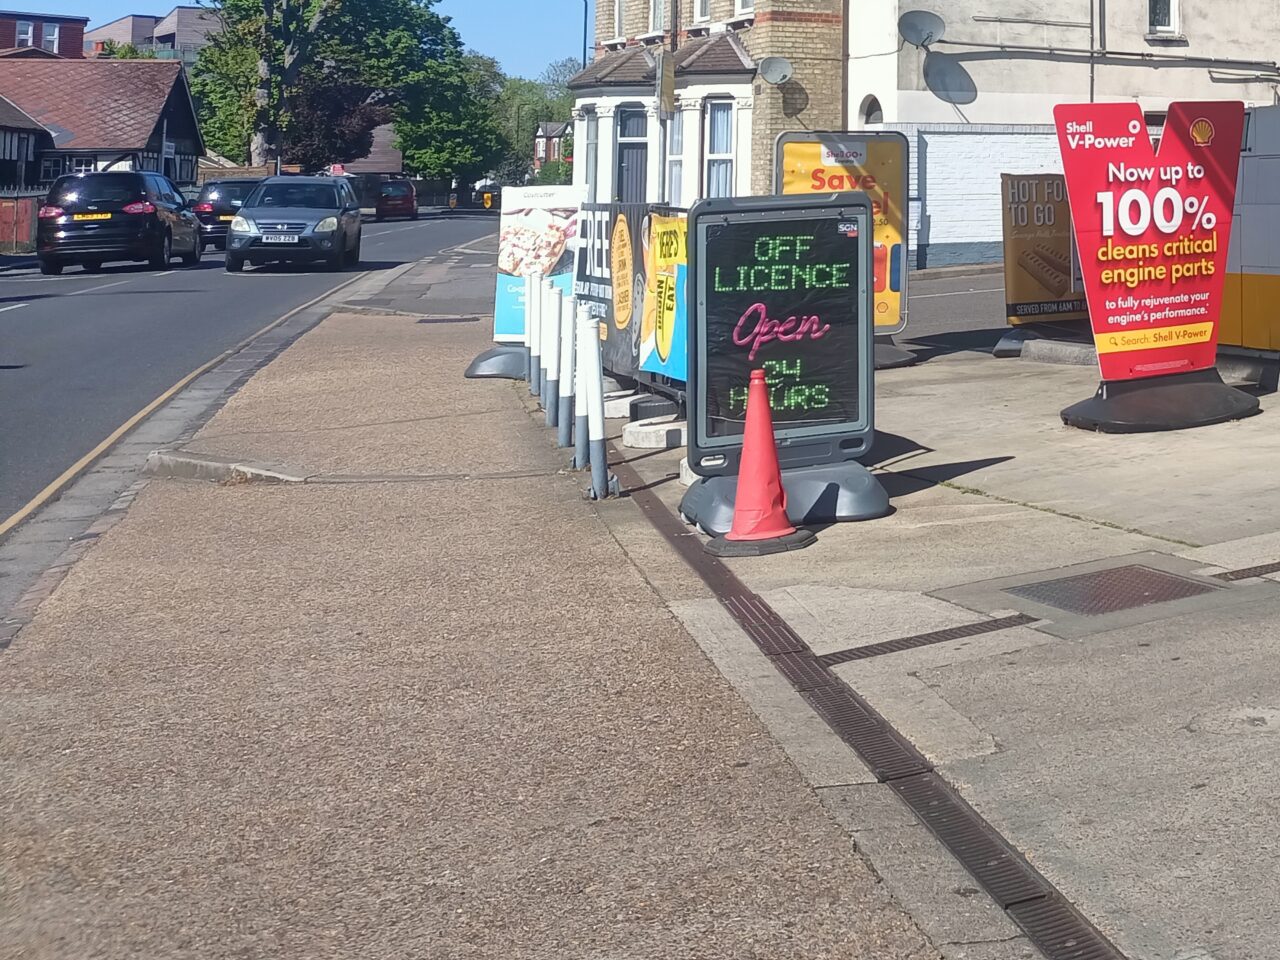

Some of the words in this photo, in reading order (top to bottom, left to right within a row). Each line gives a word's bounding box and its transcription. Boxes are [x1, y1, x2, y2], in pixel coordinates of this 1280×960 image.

[1066, 121, 1093, 133] Shell
[1066, 134, 1136, 149] V-Power
[811, 168, 876, 190] Save
[1108, 163, 1155, 182] Now
[1160, 164, 1183, 185] up
[1186, 160, 1204, 179] to
[1008, 180, 1039, 203] HOT
[1008, 204, 1028, 227] TO
[1033, 204, 1055, 226] GO
[1097, 187, 1217, 237] 100%
[839, 223, 858, 232] SGN
[754, 235, 814, 261] OFF
[1097, 236, 1159, 262] cleans
[1163, 231, 1217, 258] critical
[714, 263, 850, 292] LICENCE
[1101, 261, 1167, 288] engine
[1171, 259, 1215, 283] parts
[1016, 303, 1040, 315] SERVED
[1040, 301, 1058, 313] FROM
[1105, 300, 1116, 309] to
[1118, 297, 1139, 310] fully
[1141, 294, 1189, 308] rejuvenate
[1190, 292, 1210, 304] your
[1108, 310, 1149, 325] engine's
[732, 302, 831, 361] Open
[1121, 336, 1151, 346] Search:
[1153, 331, 1173, 343] Shell
[1174, 329, 1208, 340] V-Power
[762, 358, 801, 384] 24
[730, 384, 829, 411] HURS
